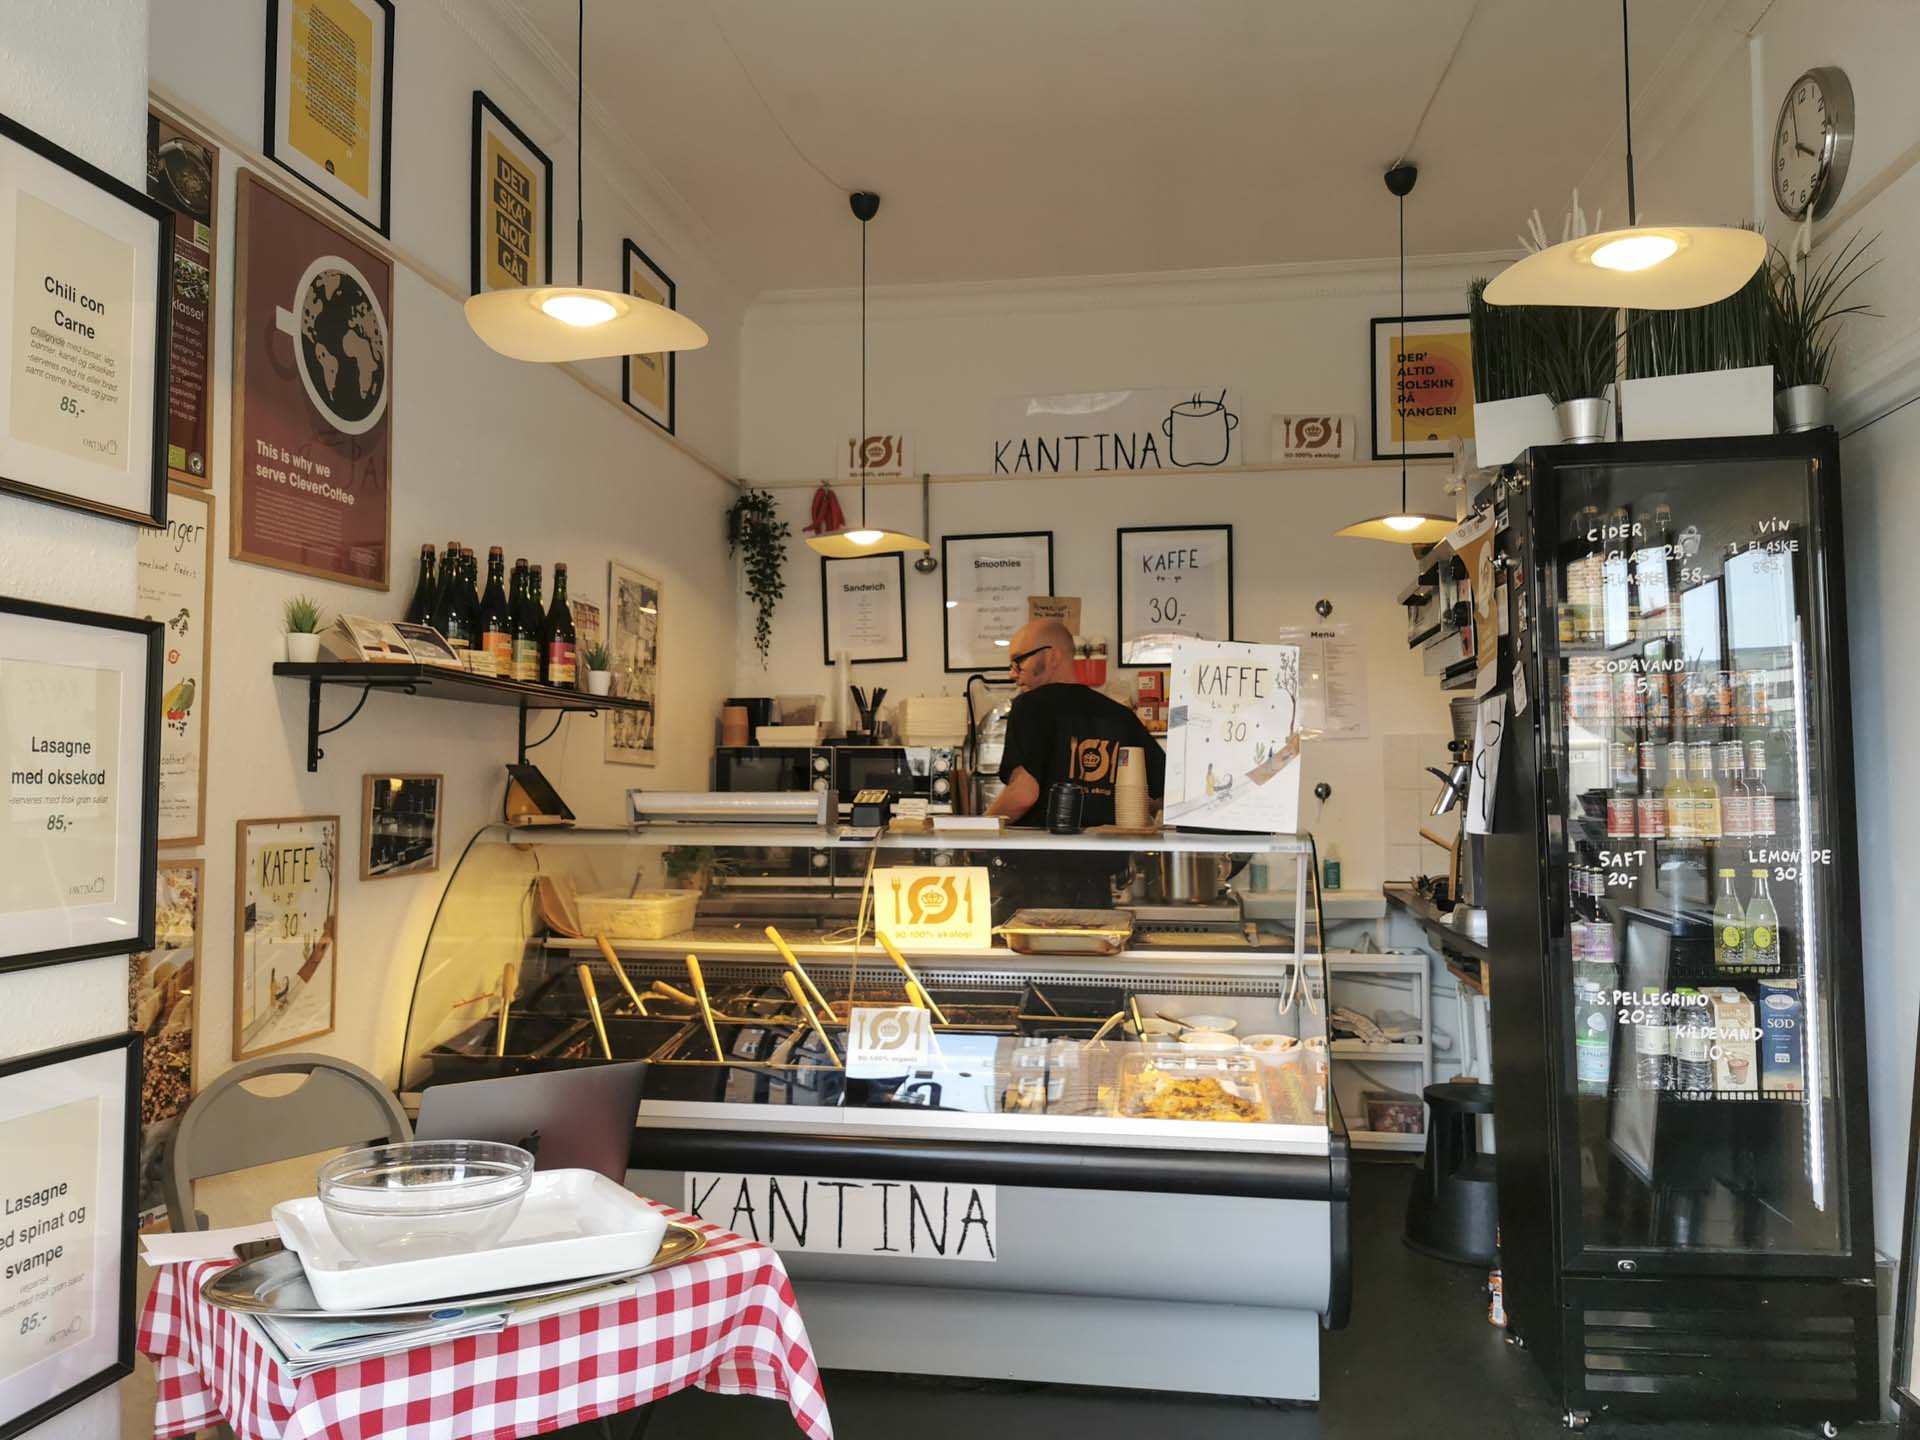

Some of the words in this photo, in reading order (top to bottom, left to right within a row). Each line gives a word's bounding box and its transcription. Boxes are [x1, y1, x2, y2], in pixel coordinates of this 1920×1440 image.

[501, 161, 526, 196] DET
[500, 217, 527, 253] NOK
[44, 276, 76, 303] Chili
[80, 295, 105, 316] con
[54, 310, 95, 339] Carne
[1397, 352, 1428, 363] DER'
[1397, 366, 1435, 376] ALTID
[1397, 379, 1455, 390] SOLSKIN
[60, 396, 86, 418] 85,-
[1398, 391, 1415, 403] PÅ
[1398, 406, 1457, 417] VANGEN!
[256, 439, 278, 461] This
[281, 448, 290, 464] is
[292, 455, 313, 474] why
[316, 463, 331, 478] we
[994, 433, 1162, 474] KANTINA
[256, 464, 286, 484] serve
[289, 472, 355, 505] CleverCoffee
[974, 560, 1021, 569] Smoothies
[1143, 549, 1199, 573] KAFFE
[843, 583, 886, 592] Sandwich
[1680, 567, 1711, 586] 58,-
[1149, 597, 1187, 625] 30,-
[1310, 631, 1335, 639] Menu
[1594, 658, 1684, 673] SODAVAND
[1197, 664, 1268, 699] KAFFE
[1224, 720, 1247, 742] 30
[31, 736, 91, 758] Lasagne
[12, 769, 43, 785] med
[48, 769, 105, 785] oksekød
[47, 814, 73, 832] 85,-
[262, 847, 315, 888] KAFFE
[1598, 850, 1647, 868] SAFT
[1607, 872, 1638, 889] 20,-
[282, 913, 298, 939] 30
[1766, 1017, 1796, 1029] SØD
[5, 1182, 68, 1215] Lasagne
[19, 1212, 64, 1244] spinat
[68, 1206, 86, 1225] og
[691, 1177, 995, 1259] KANTINA
[6, 1245, 64, 1280] svampe
